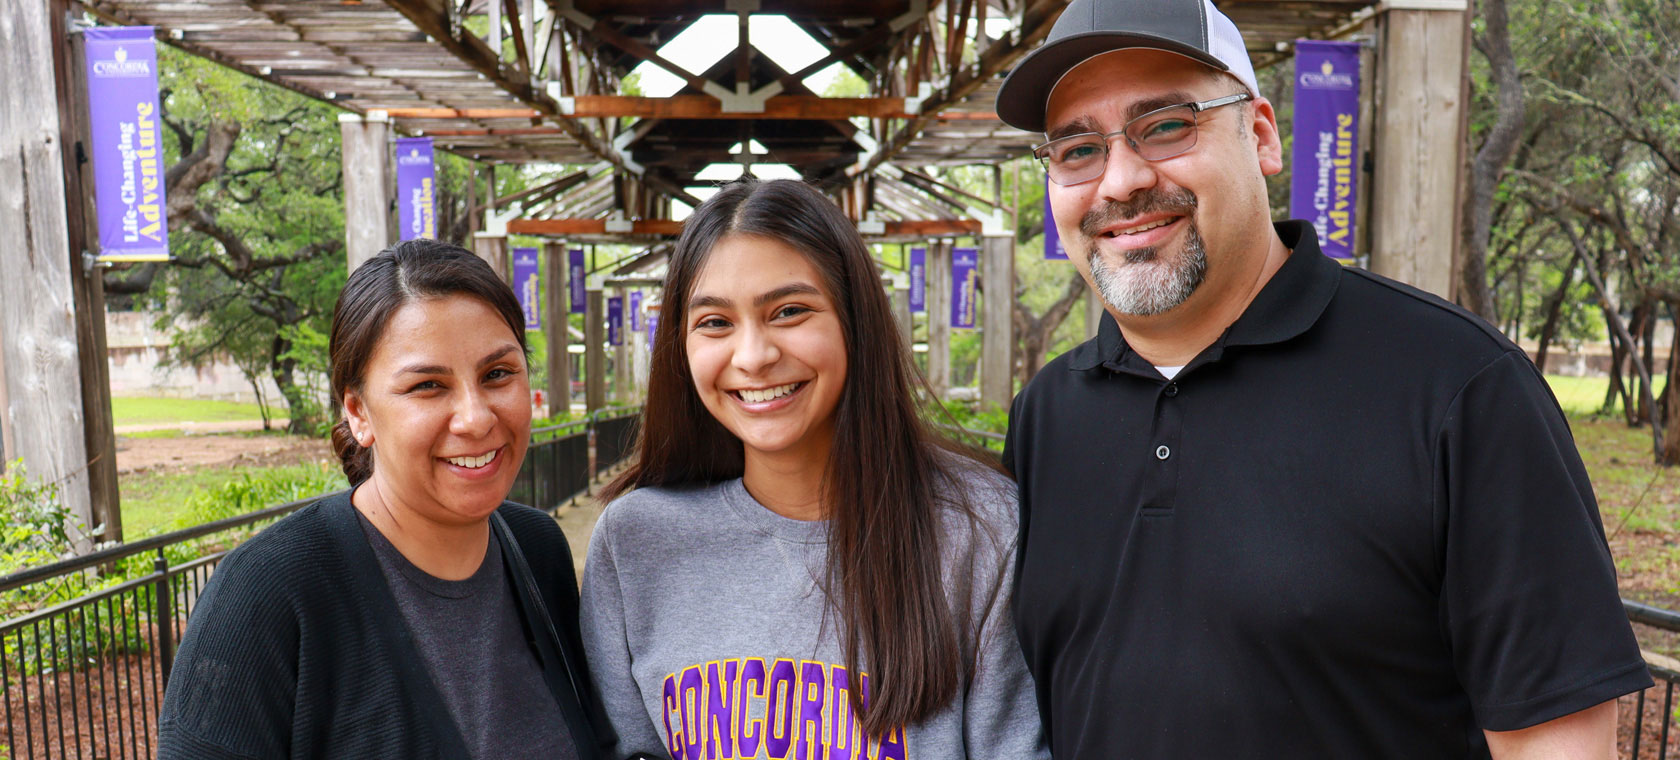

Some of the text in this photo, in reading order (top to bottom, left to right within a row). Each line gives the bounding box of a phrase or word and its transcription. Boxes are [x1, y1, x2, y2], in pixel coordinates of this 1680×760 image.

[118, 122, 139, 242] Life-Changing
[137, 102, 161, 242] Adventure
[411, 188, 422, 239] e-Changing
[420, 177, 434, 240] ducation
[1313, 131, 1334, 246] Life-Changing
[1328, 113, 1352, 247] Adventure
